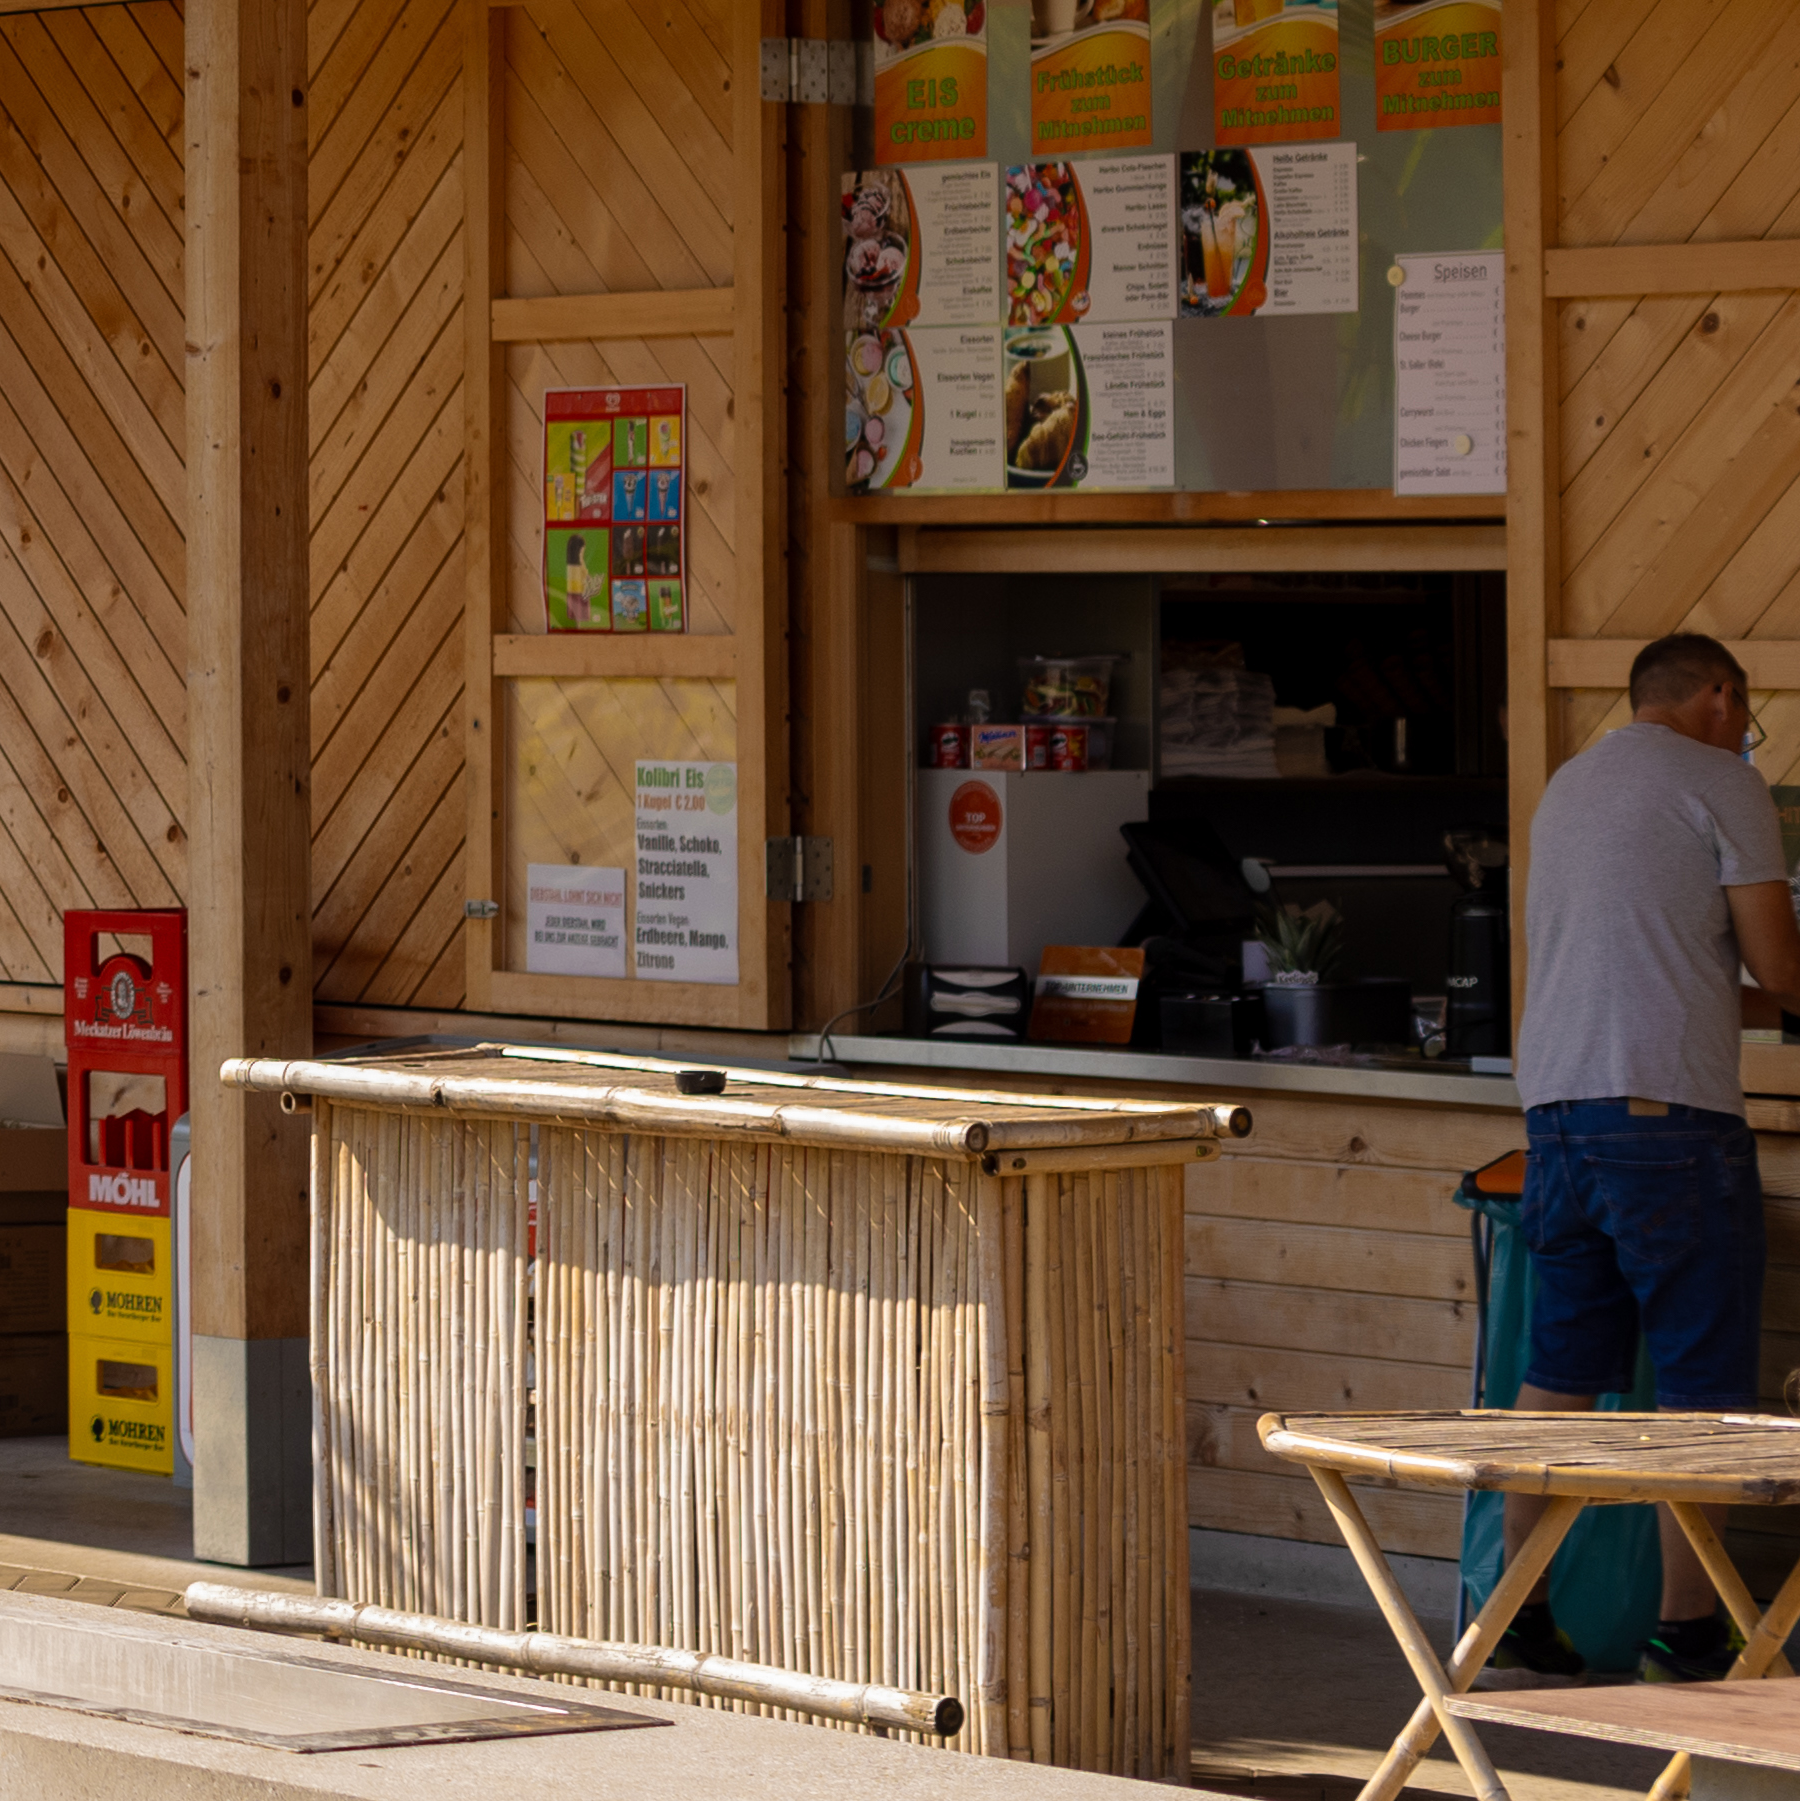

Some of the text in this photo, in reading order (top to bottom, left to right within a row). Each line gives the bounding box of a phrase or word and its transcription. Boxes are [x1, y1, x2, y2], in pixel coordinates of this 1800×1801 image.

[1383, 30, 1499, 64] BURGER
[1218, 48, 1336, 80] Getränke
[1037, 62, 1144, 93] Frühstück
[1418, 66, 1461, 88] zum
[906, 76, 960, 110] EIS
[1256, 82, 1297, 103] zum
[1383, 88, 1499, 115] Mitnehmen
[1071, 94, 1110, 115] zum
[1037, 113, 1146, 140] Mitnehmen
[1221, 104, 1335, 130] Mitnehmen
[890, 117, 976, 144] creme
[1434, 263, 1488, 281] Speisen
[1130, 328, 1164, 338] Frühstück
[1130, 380, 1165, 389] Frühstück
[637, 766, 704, 788] Kolibri Eis
[643, 795, 672, 812] Kugel
[964, 811, 987, 824] TOP
[637, 834, 722, 855] Vanille, Schoko,
[639, 857, 710, 878] Stracciatella,
[639, 882, 685, 901] Snickers
[636, 927, 729, 950] Erdbeere, Mango,
[637, 951, 675, 970] Zitrone
[74, 1020, 173, 1043] Meckatzer Löwenbräu
[88, 1172, 161, 1208] MÖHL
[106, 1291, 163, 1313] MOHREN
[108, 1419, 165, 1442] MOHREN
